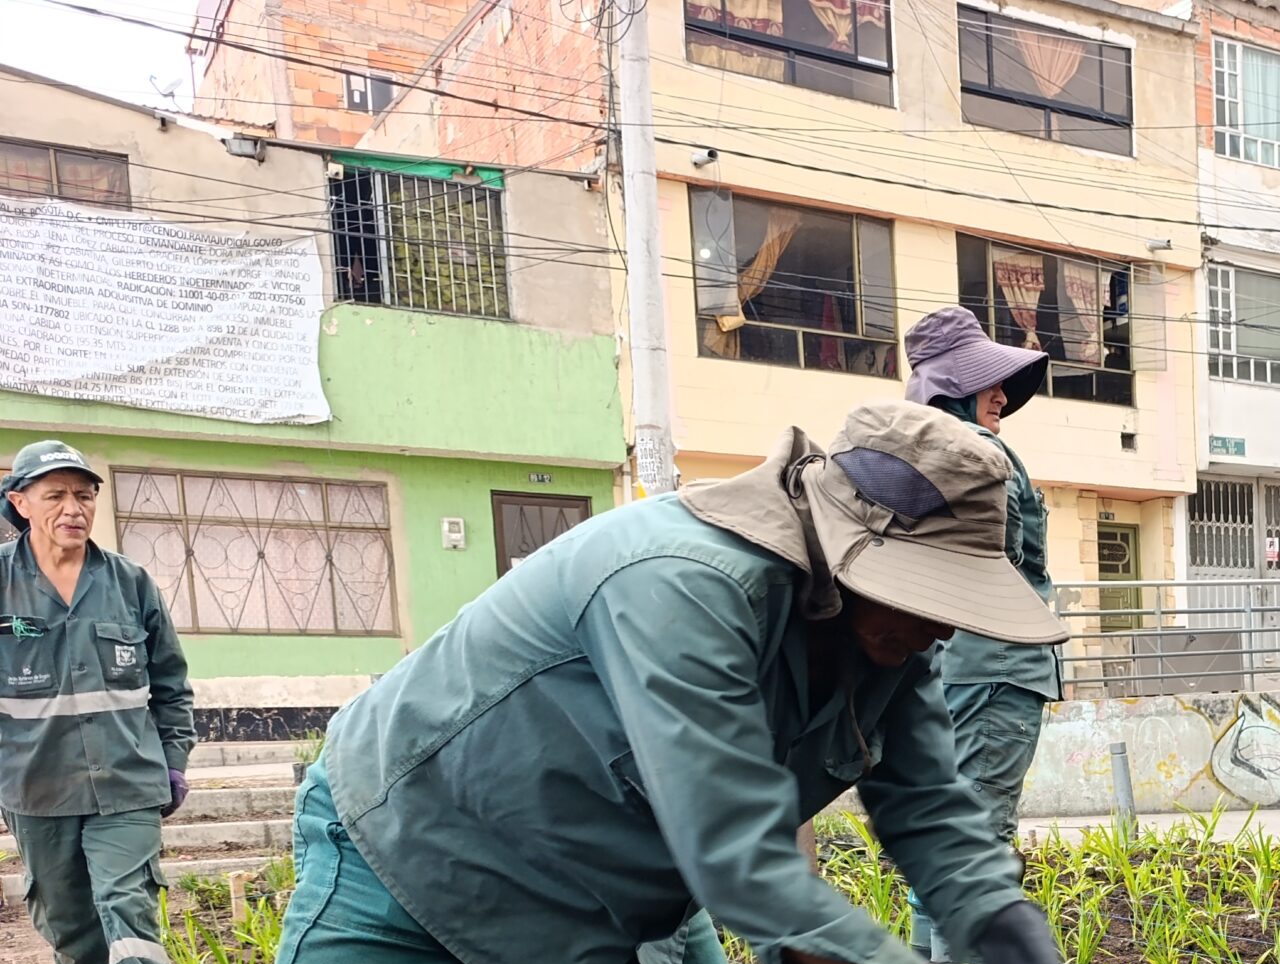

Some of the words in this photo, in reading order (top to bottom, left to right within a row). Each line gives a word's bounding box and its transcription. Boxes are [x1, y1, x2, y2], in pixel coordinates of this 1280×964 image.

[16, 276, 95, 296] EXTRAORDINARIA
[156, 299, 169, 309] DE
[171, 301, 213, 313] DOMINIO
